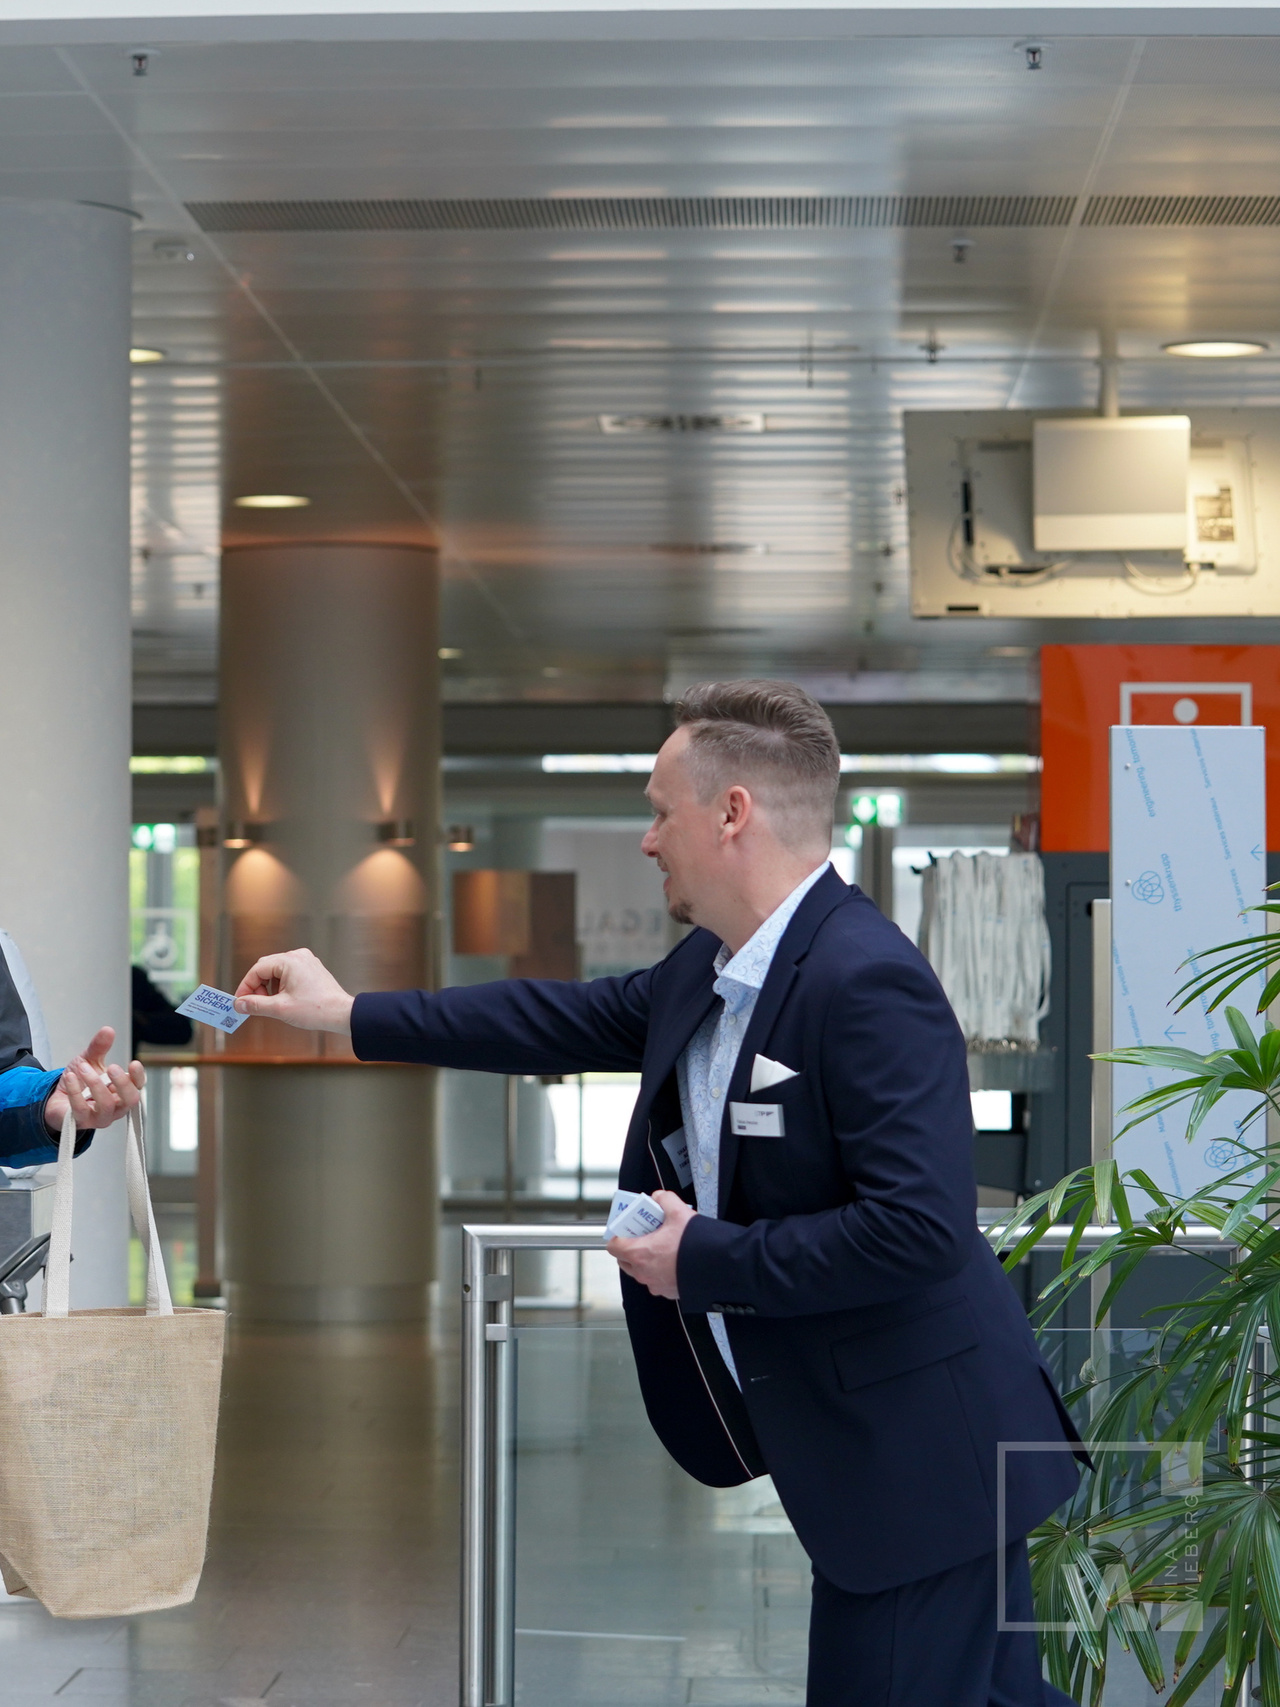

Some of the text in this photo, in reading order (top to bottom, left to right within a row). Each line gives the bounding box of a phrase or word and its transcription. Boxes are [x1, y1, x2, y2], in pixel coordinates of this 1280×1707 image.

[1125, 728, 1140, 764] tomorro
[1160, 853, 1182, 912] thyssenkrupp
[195, 995, 232, 1012] SICHERN
[201, 989, 232, 1004] TICKET
